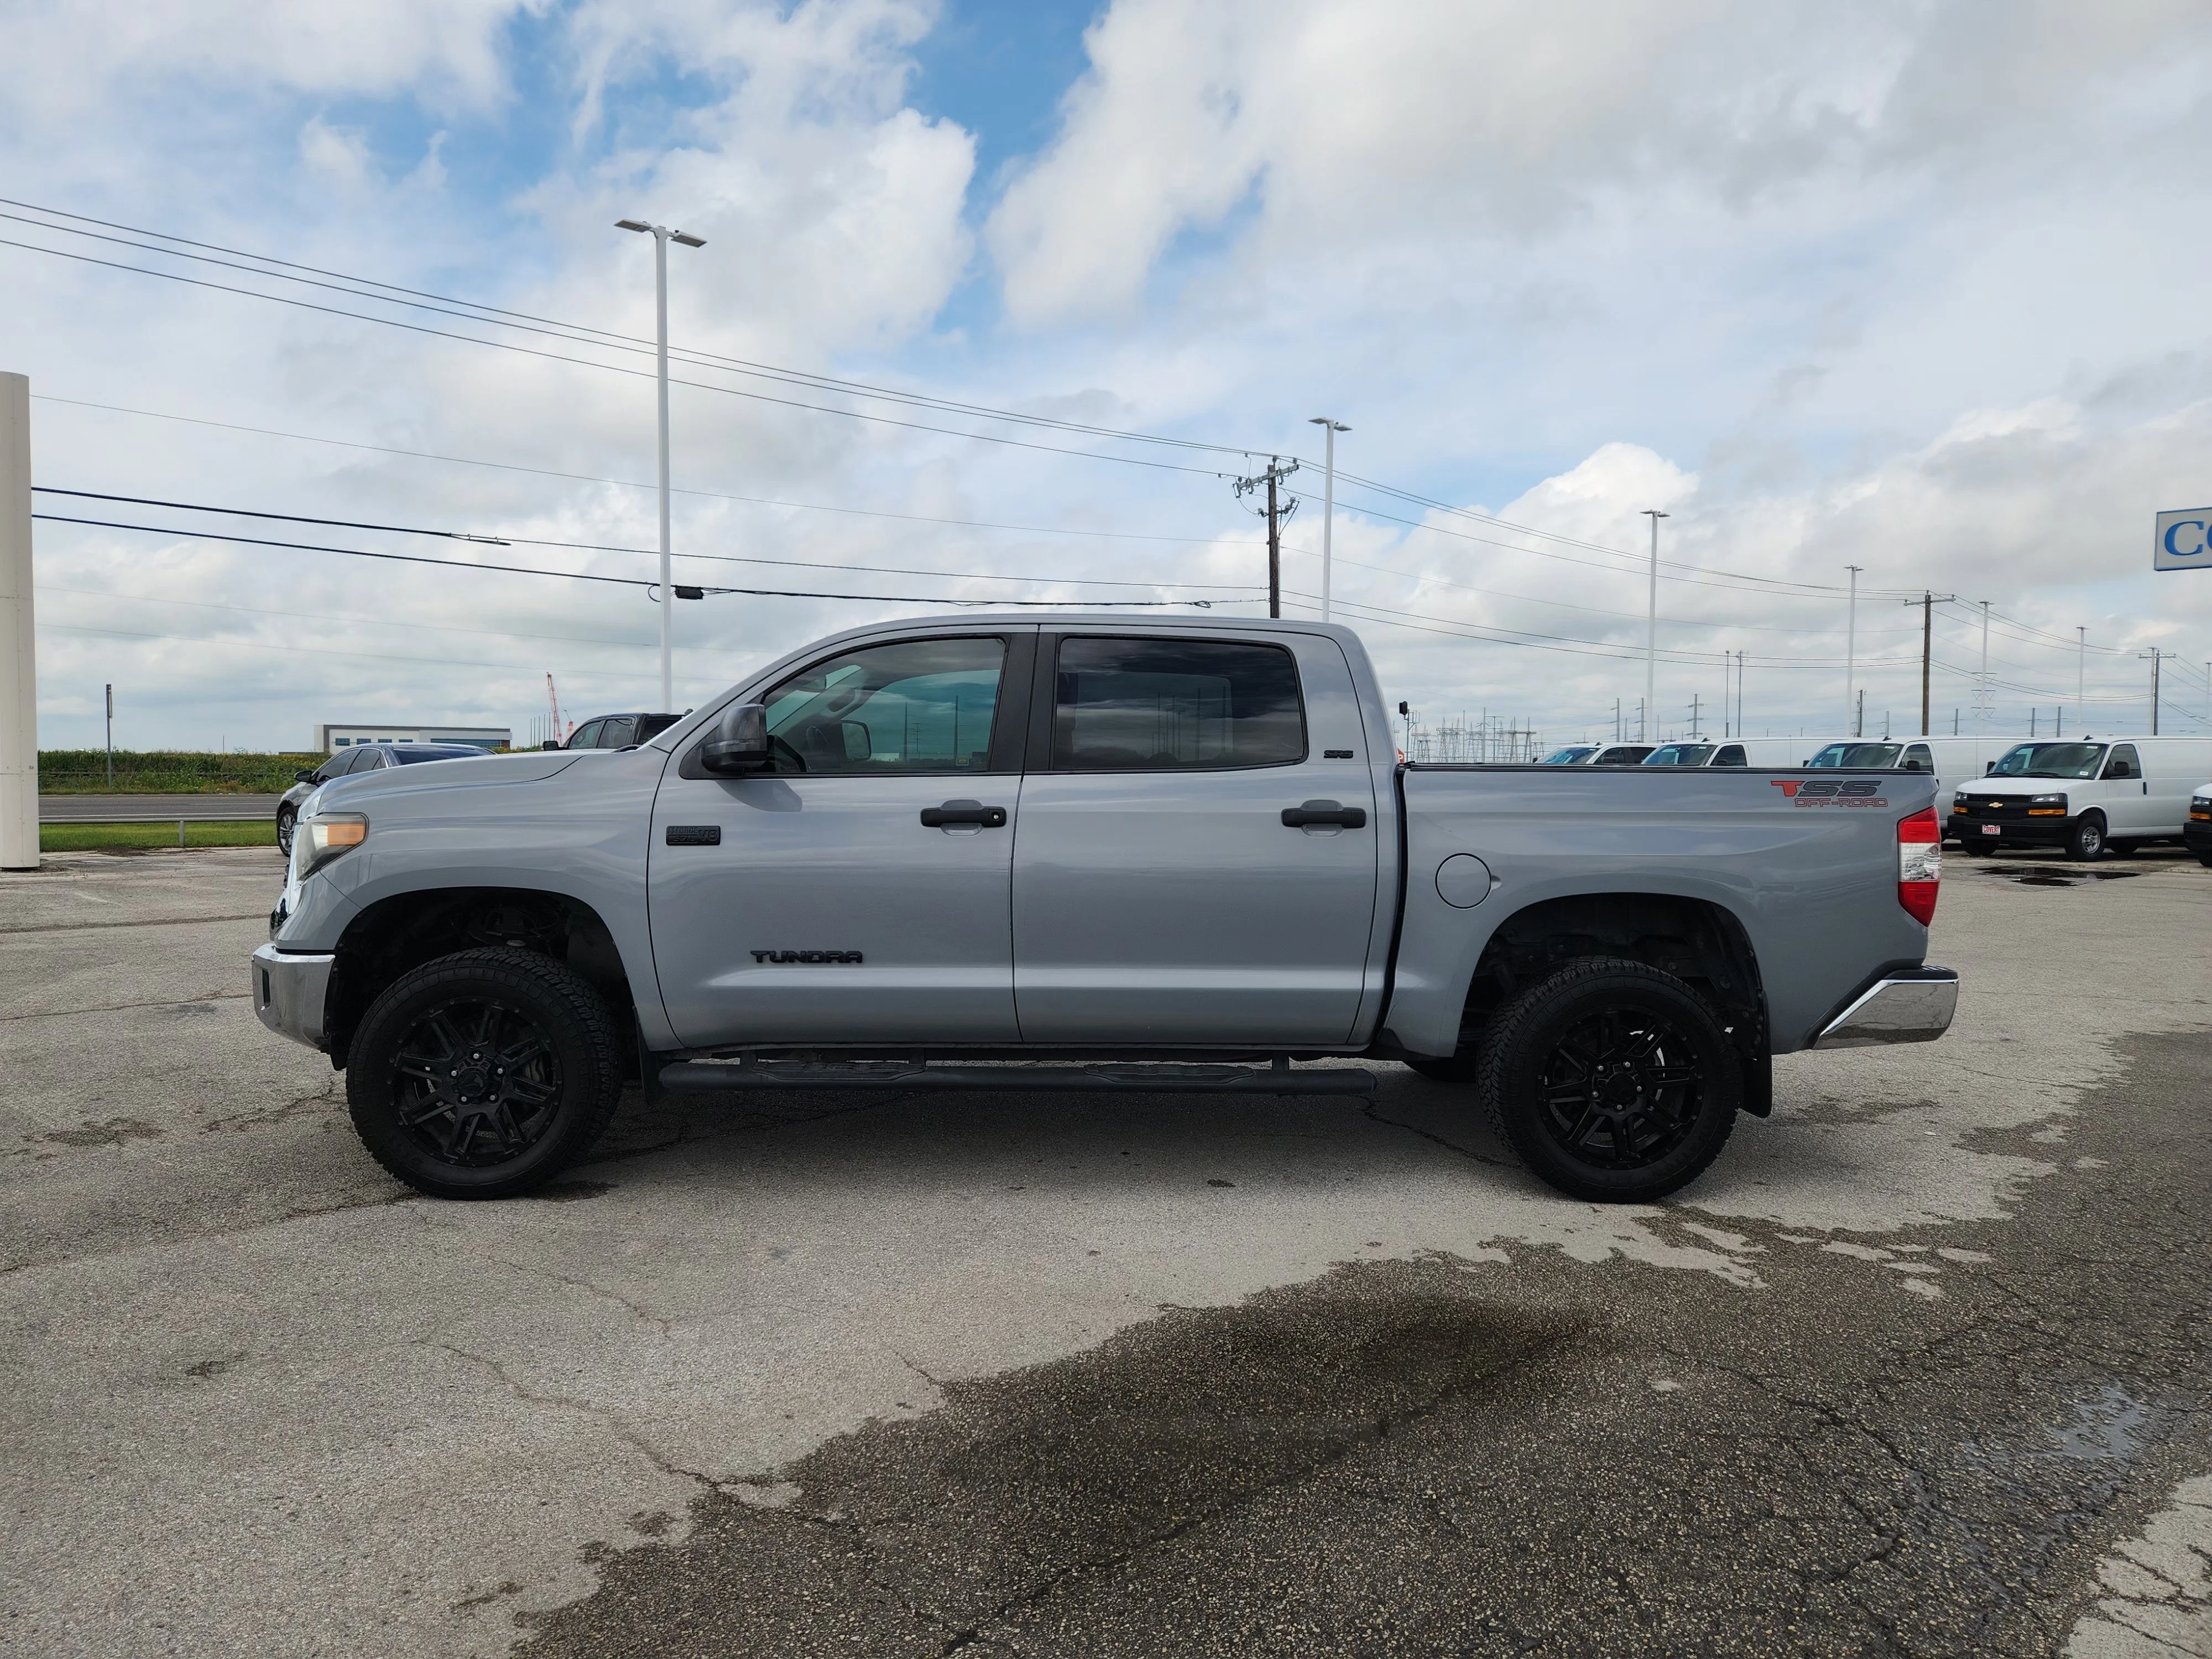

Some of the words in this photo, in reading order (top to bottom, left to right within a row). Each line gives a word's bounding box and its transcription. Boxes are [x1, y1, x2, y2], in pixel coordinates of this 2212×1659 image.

[2164, 520, 2212, 556] C
[1771, 781, 1882, 797] TSS
[1794, 798, 1888, 807] OFF-ROAD
[698, 830, 718, 841] V8
[750, 951, 863, 963] TUNDRA
